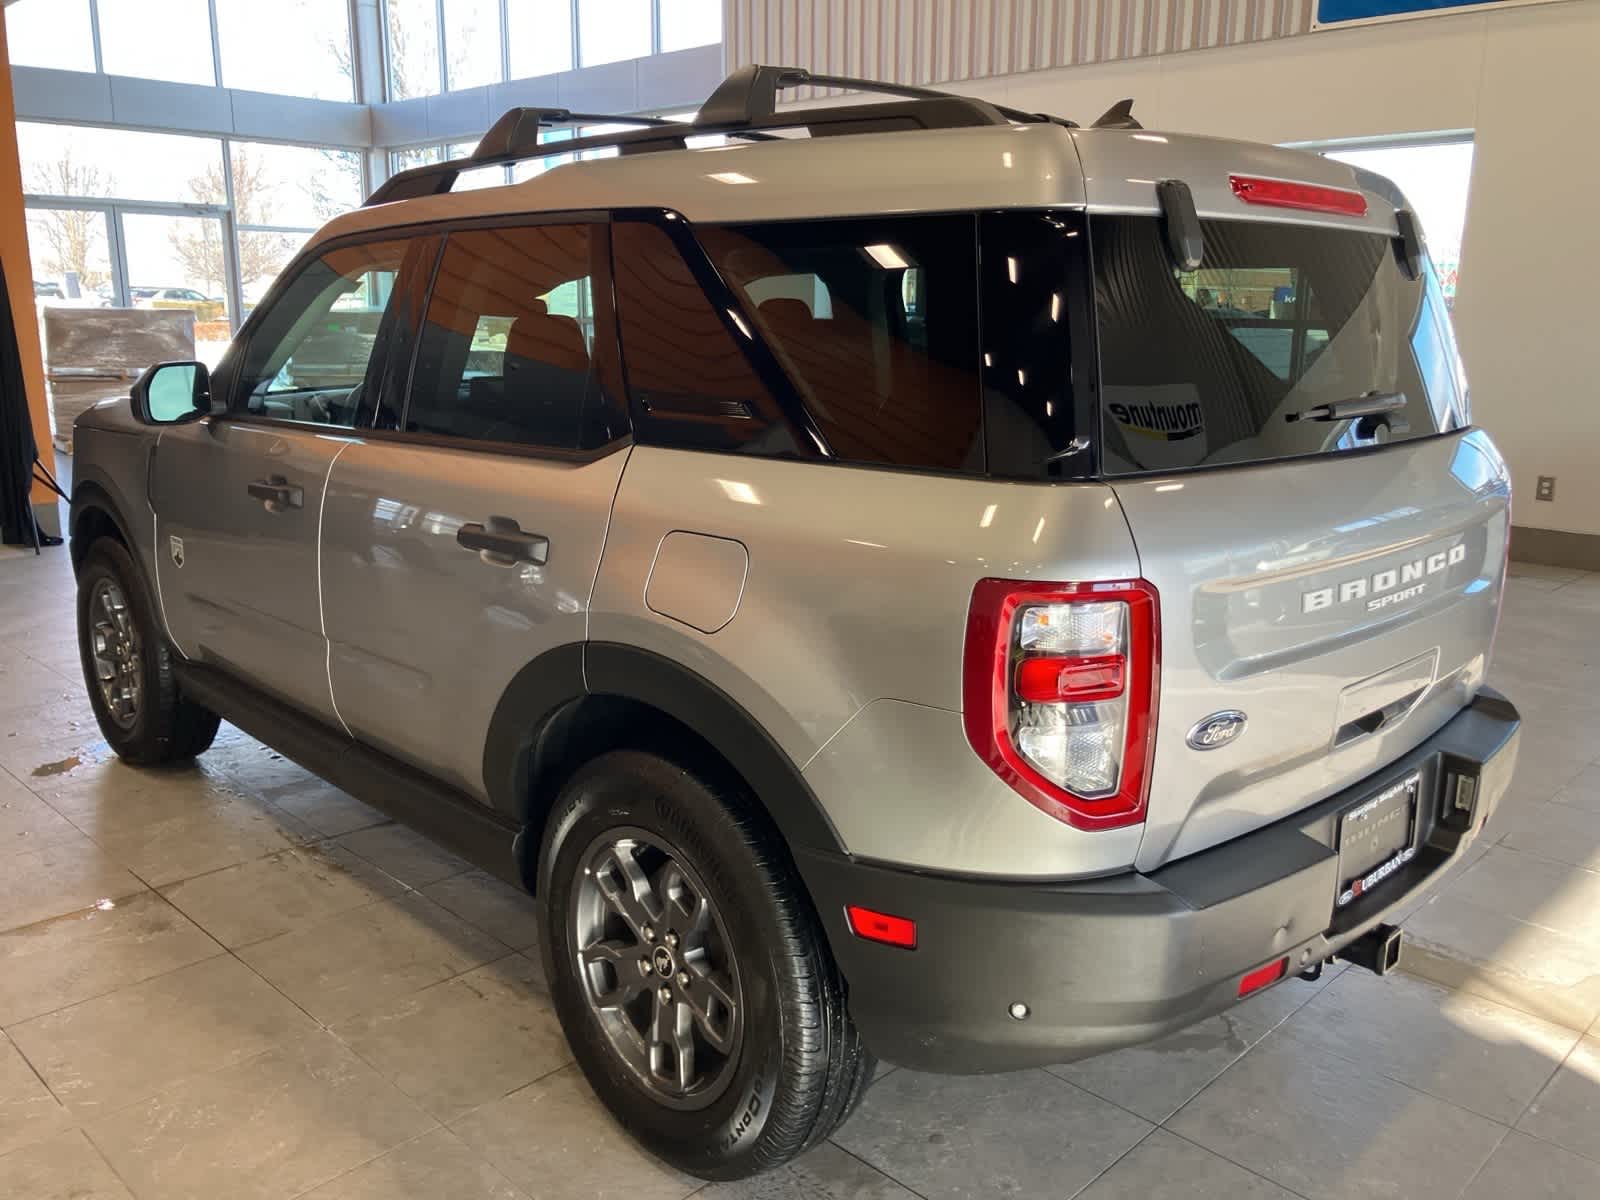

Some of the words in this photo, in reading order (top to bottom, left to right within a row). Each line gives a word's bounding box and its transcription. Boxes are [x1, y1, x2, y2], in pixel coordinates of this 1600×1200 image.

[1302, 543, 1466, 614] BRONCO
[1367, 583, 1427, 612] SPORT
[1203, 720, 1238, 744] Ford
